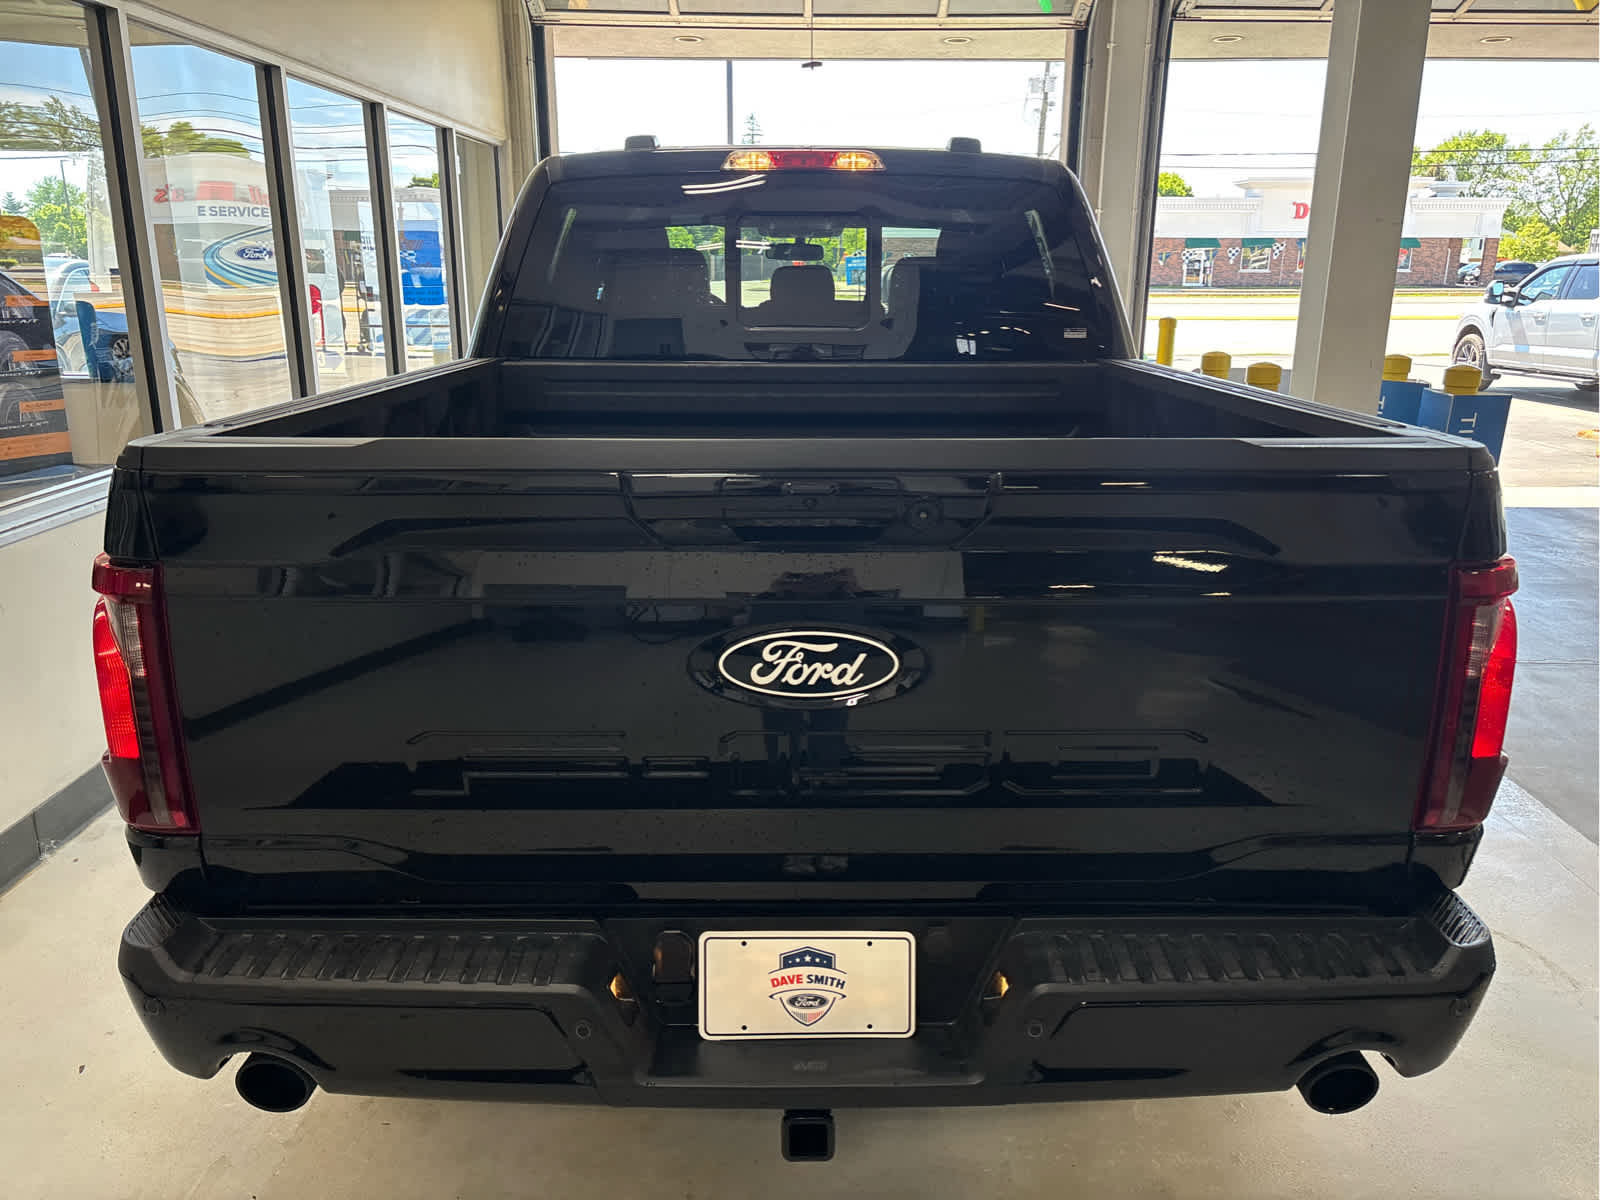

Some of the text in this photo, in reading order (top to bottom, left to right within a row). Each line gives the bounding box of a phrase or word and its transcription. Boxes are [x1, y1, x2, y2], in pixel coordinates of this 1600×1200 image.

[208, 206, 270, 218] SERVICE
[750, 640, 868, 686] Ford
[770, 974, 846, 989] DAVE SMITH
[794, 995, 821, 1007] Ford
